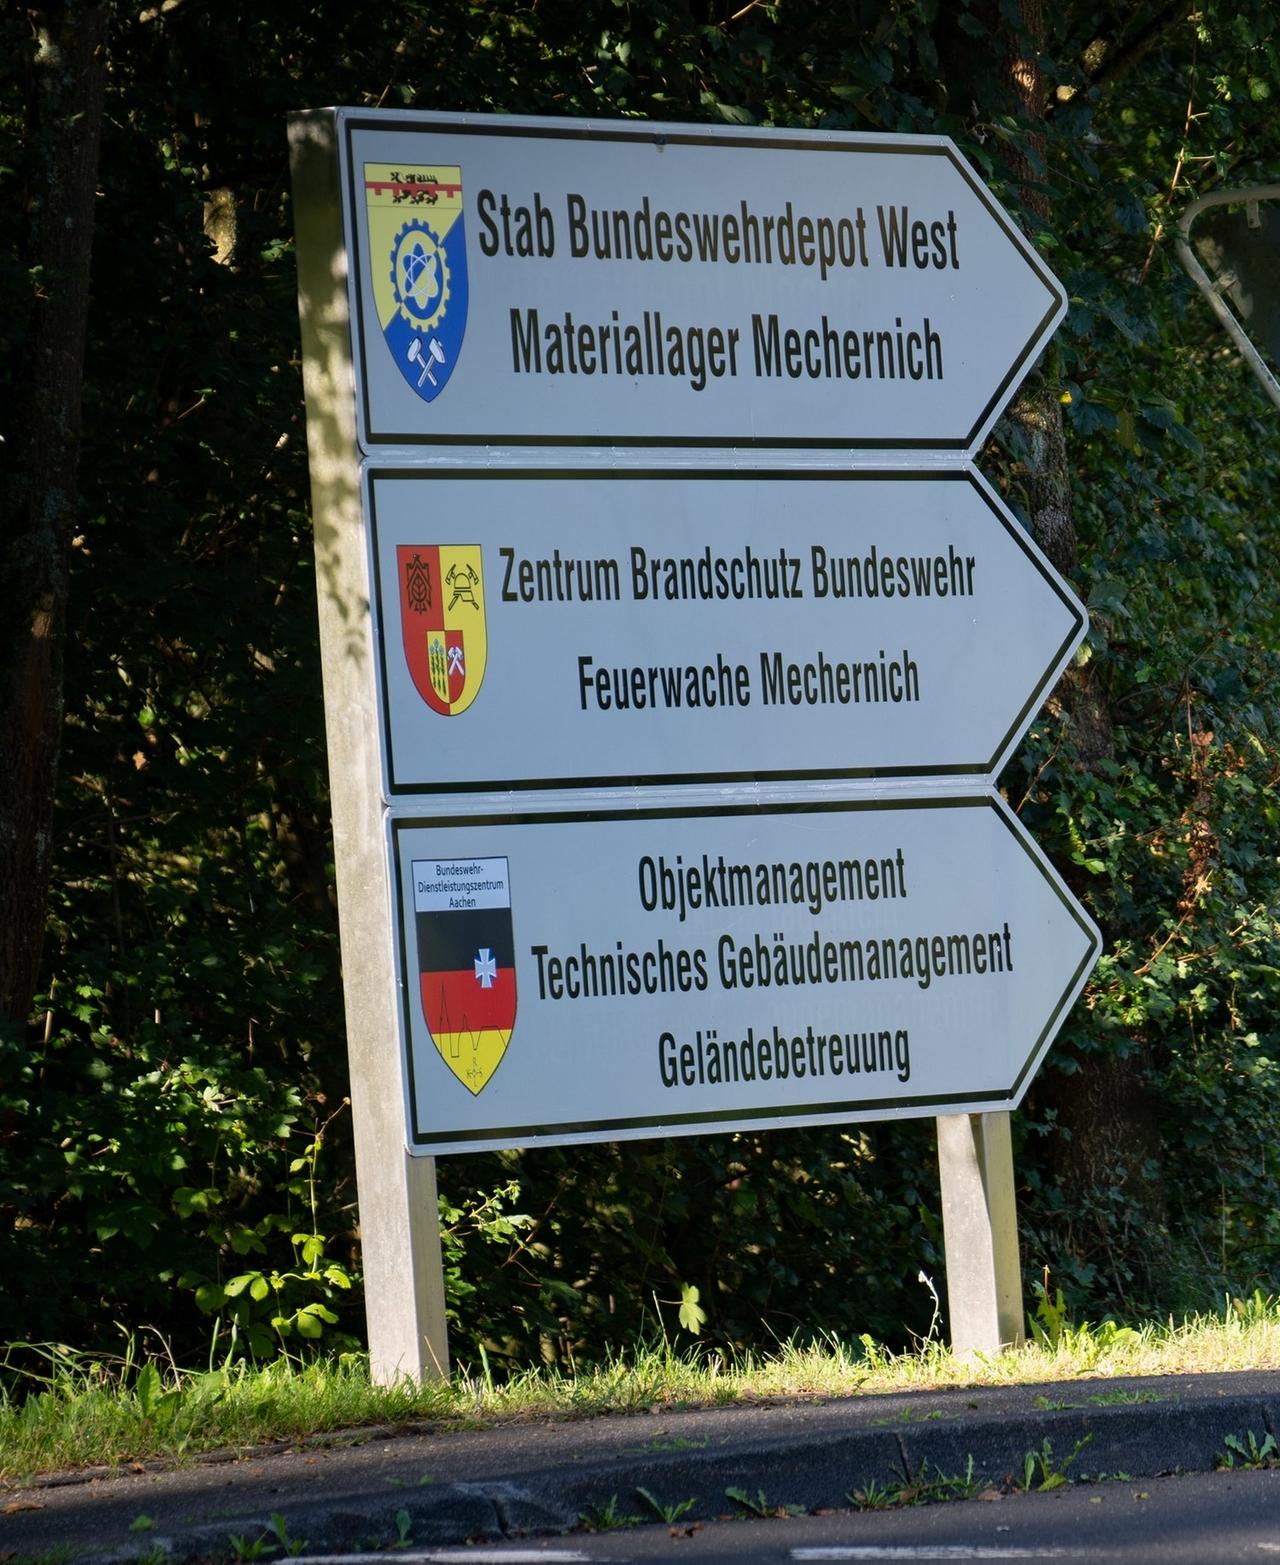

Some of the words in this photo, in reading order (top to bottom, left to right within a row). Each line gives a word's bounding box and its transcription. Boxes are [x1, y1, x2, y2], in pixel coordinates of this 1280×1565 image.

[478, 189, 554, 258] Stab
[567, 194, 868, 280] Bundeswehrdepot
[877, 206, 959, 269] West
[510, 308, 739, 391] Materiallager
[752, 314, 943, 380] Mechernich
[500, 548, 620, 602] Zentrum
[631, 546, 803, 600] Brandschutz
[811, 545, 975, 598] Bundeswehr
[578, 654, 750, 710] Feuerwache
[760, 650, 919, 705] Mechernich
[418, 880, 503, 894] Dienstleistungszentrum
[436, 863, 483, 876] Bundeswehr-
[639, 849, 906, 920] Objektmanagement
[449, 896, 476, 908] Aachen
[531, 939, 708, 999] Technisches
[718, 923, 1013, 989] Gebäudemanagement
[659, 1026, 910, 1087] Geländebetreuung
